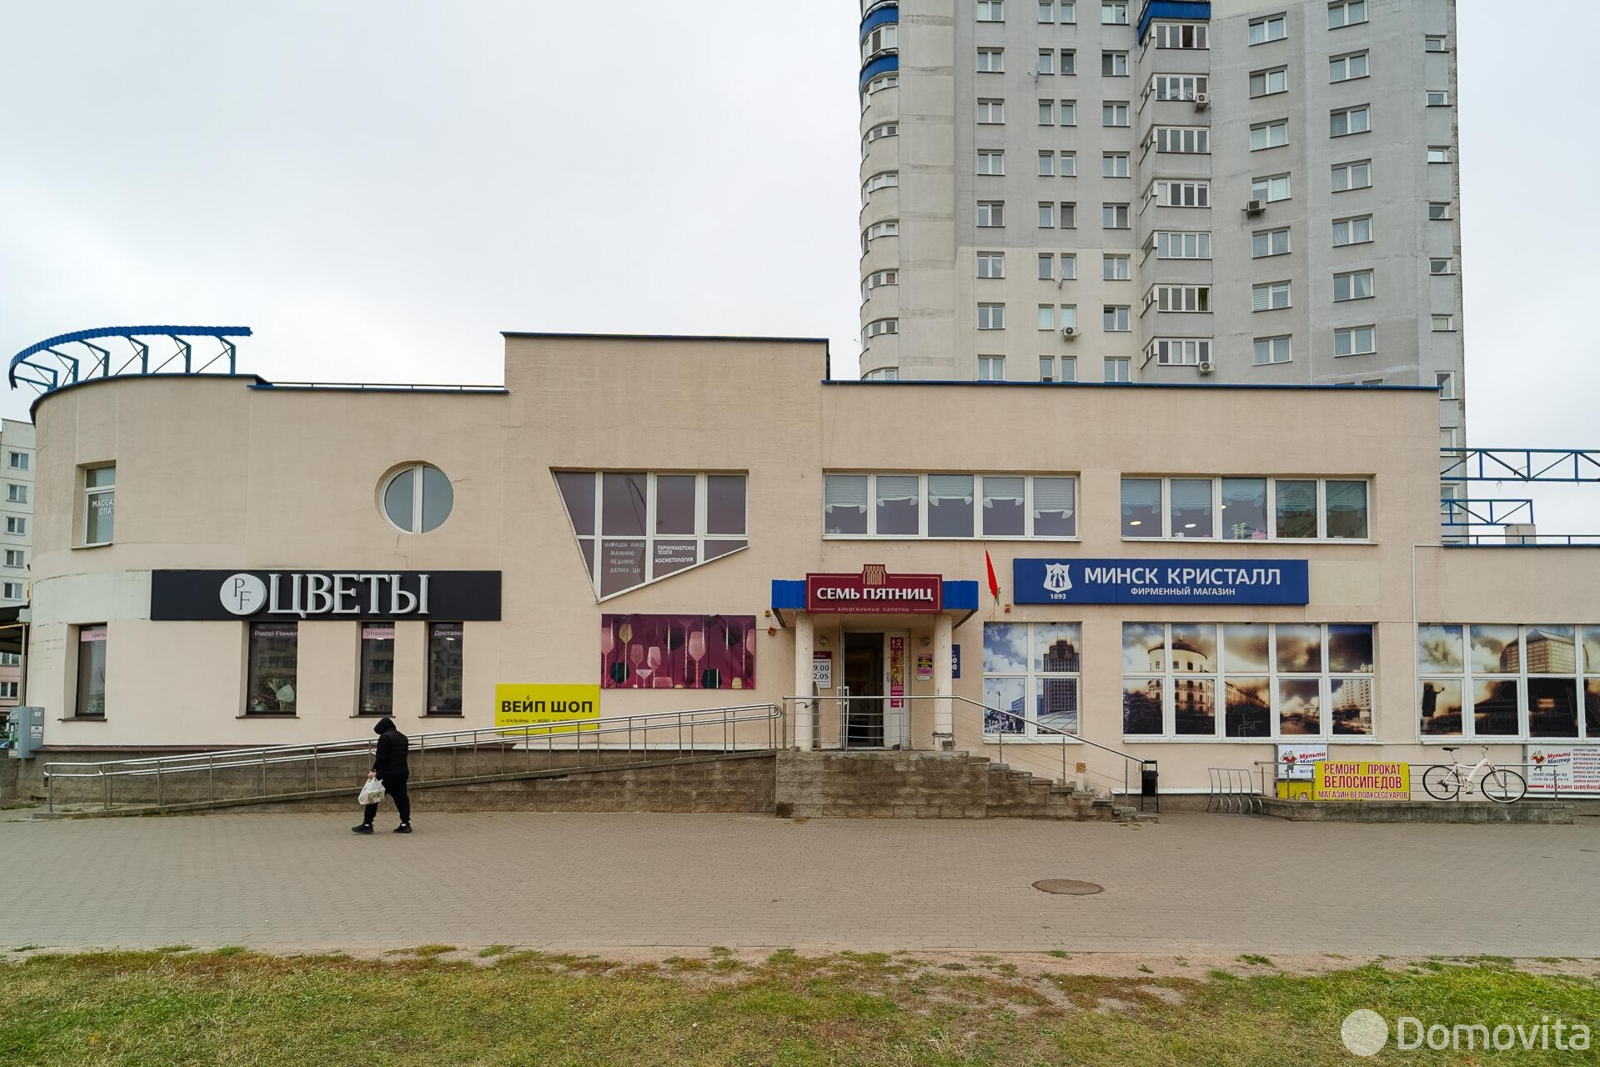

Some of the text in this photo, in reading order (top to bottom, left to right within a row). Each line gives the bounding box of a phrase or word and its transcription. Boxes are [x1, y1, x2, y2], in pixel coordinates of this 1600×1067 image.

[100, 508, 112, 516] СПА
[1084, 567, 1281, 585] МИНСК КРИСТАЛЛ
[267, 574, 431, 618] ЦВЕТЫ
[816, 587, 934, 602] СЕМЬ ПЯТНИЦ
[1130, 586, 1236, 596] ФИРМЕННЫЙ МАГАЗИН
[501, 695, 593, 713] ВЕЙП ШОП
[1299, 751, 1326, 761] Мульти
[1546, 752, 1571, 760] Мульти
[1324, 763, 1360, 775] РЕМОНТ
[1367, 764, 1401, 775] ПРОКАТ
[1324, 775, 1402, 790] ВЕЛОСИПЕДОВ
[1318, 790, 1408, 799] МАГАЗИН ВЕЛОАКСЕССУАРОВ
